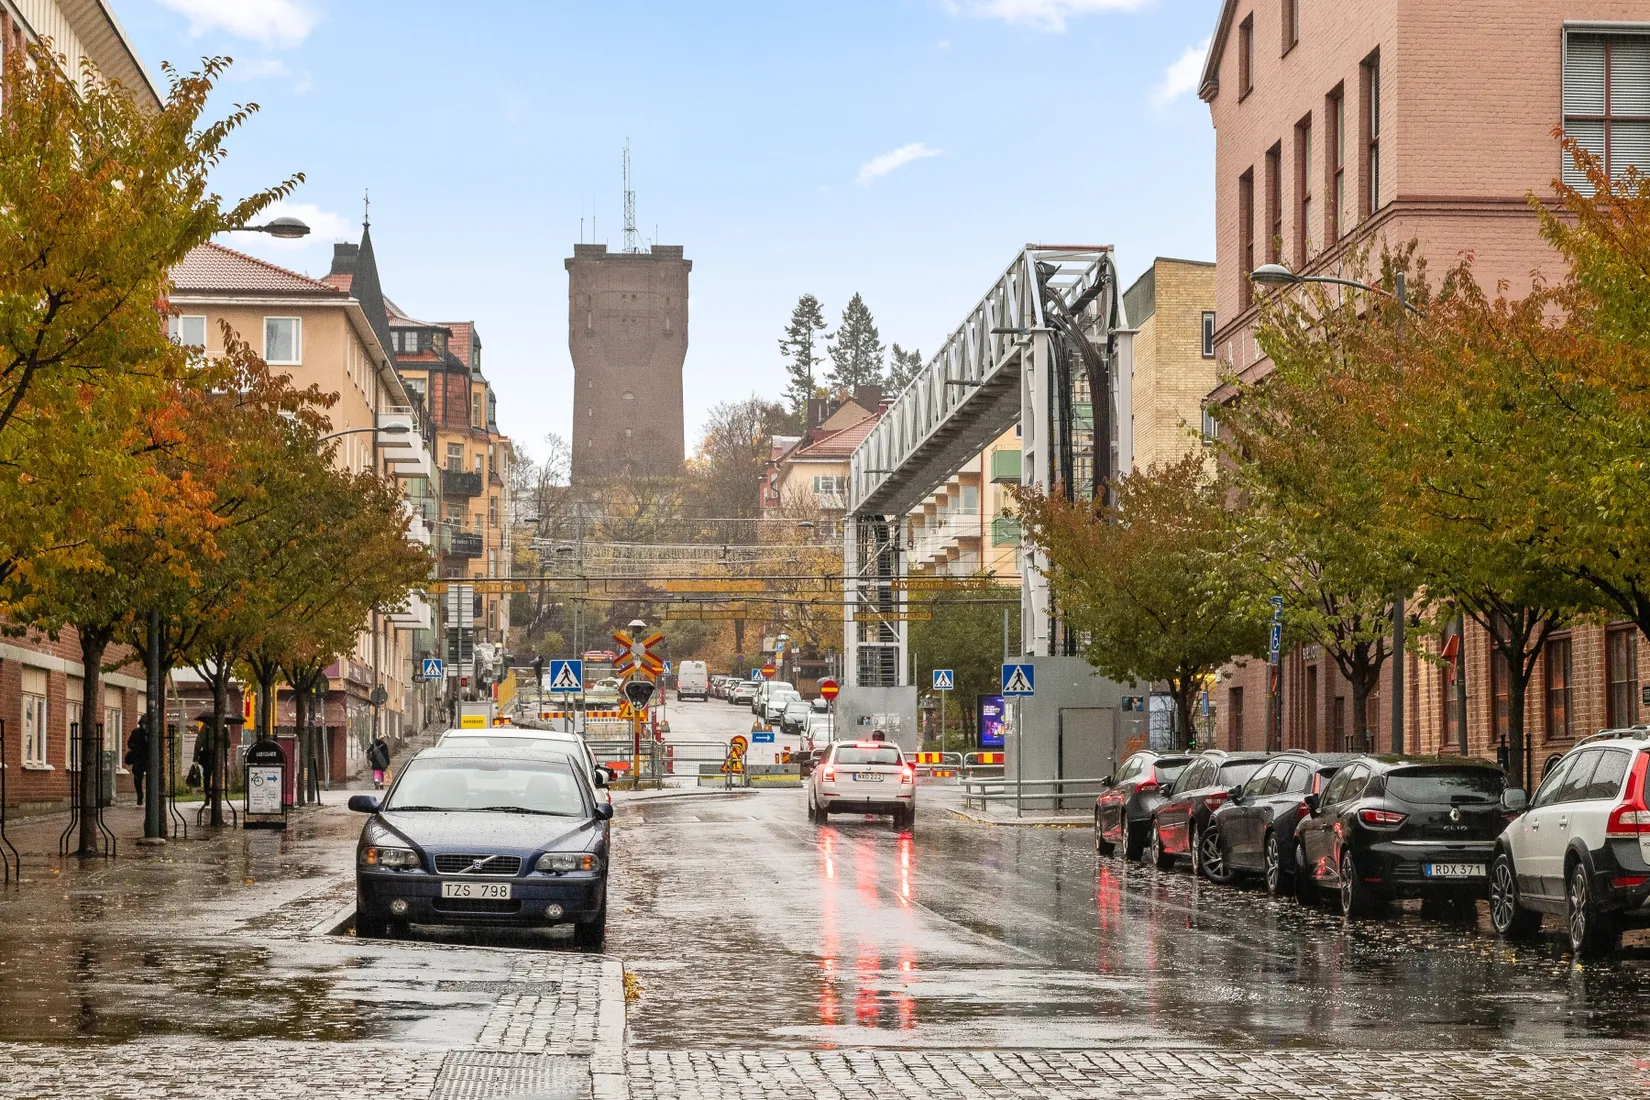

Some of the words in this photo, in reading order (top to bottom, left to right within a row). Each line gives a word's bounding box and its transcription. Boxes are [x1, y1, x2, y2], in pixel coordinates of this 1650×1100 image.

[1435, 864, 1457, 875] RDX
[1460, 864, 1481, 875] 371
[445, 884, 471, 896] TZS
[481, 885, 507, 897] 798
